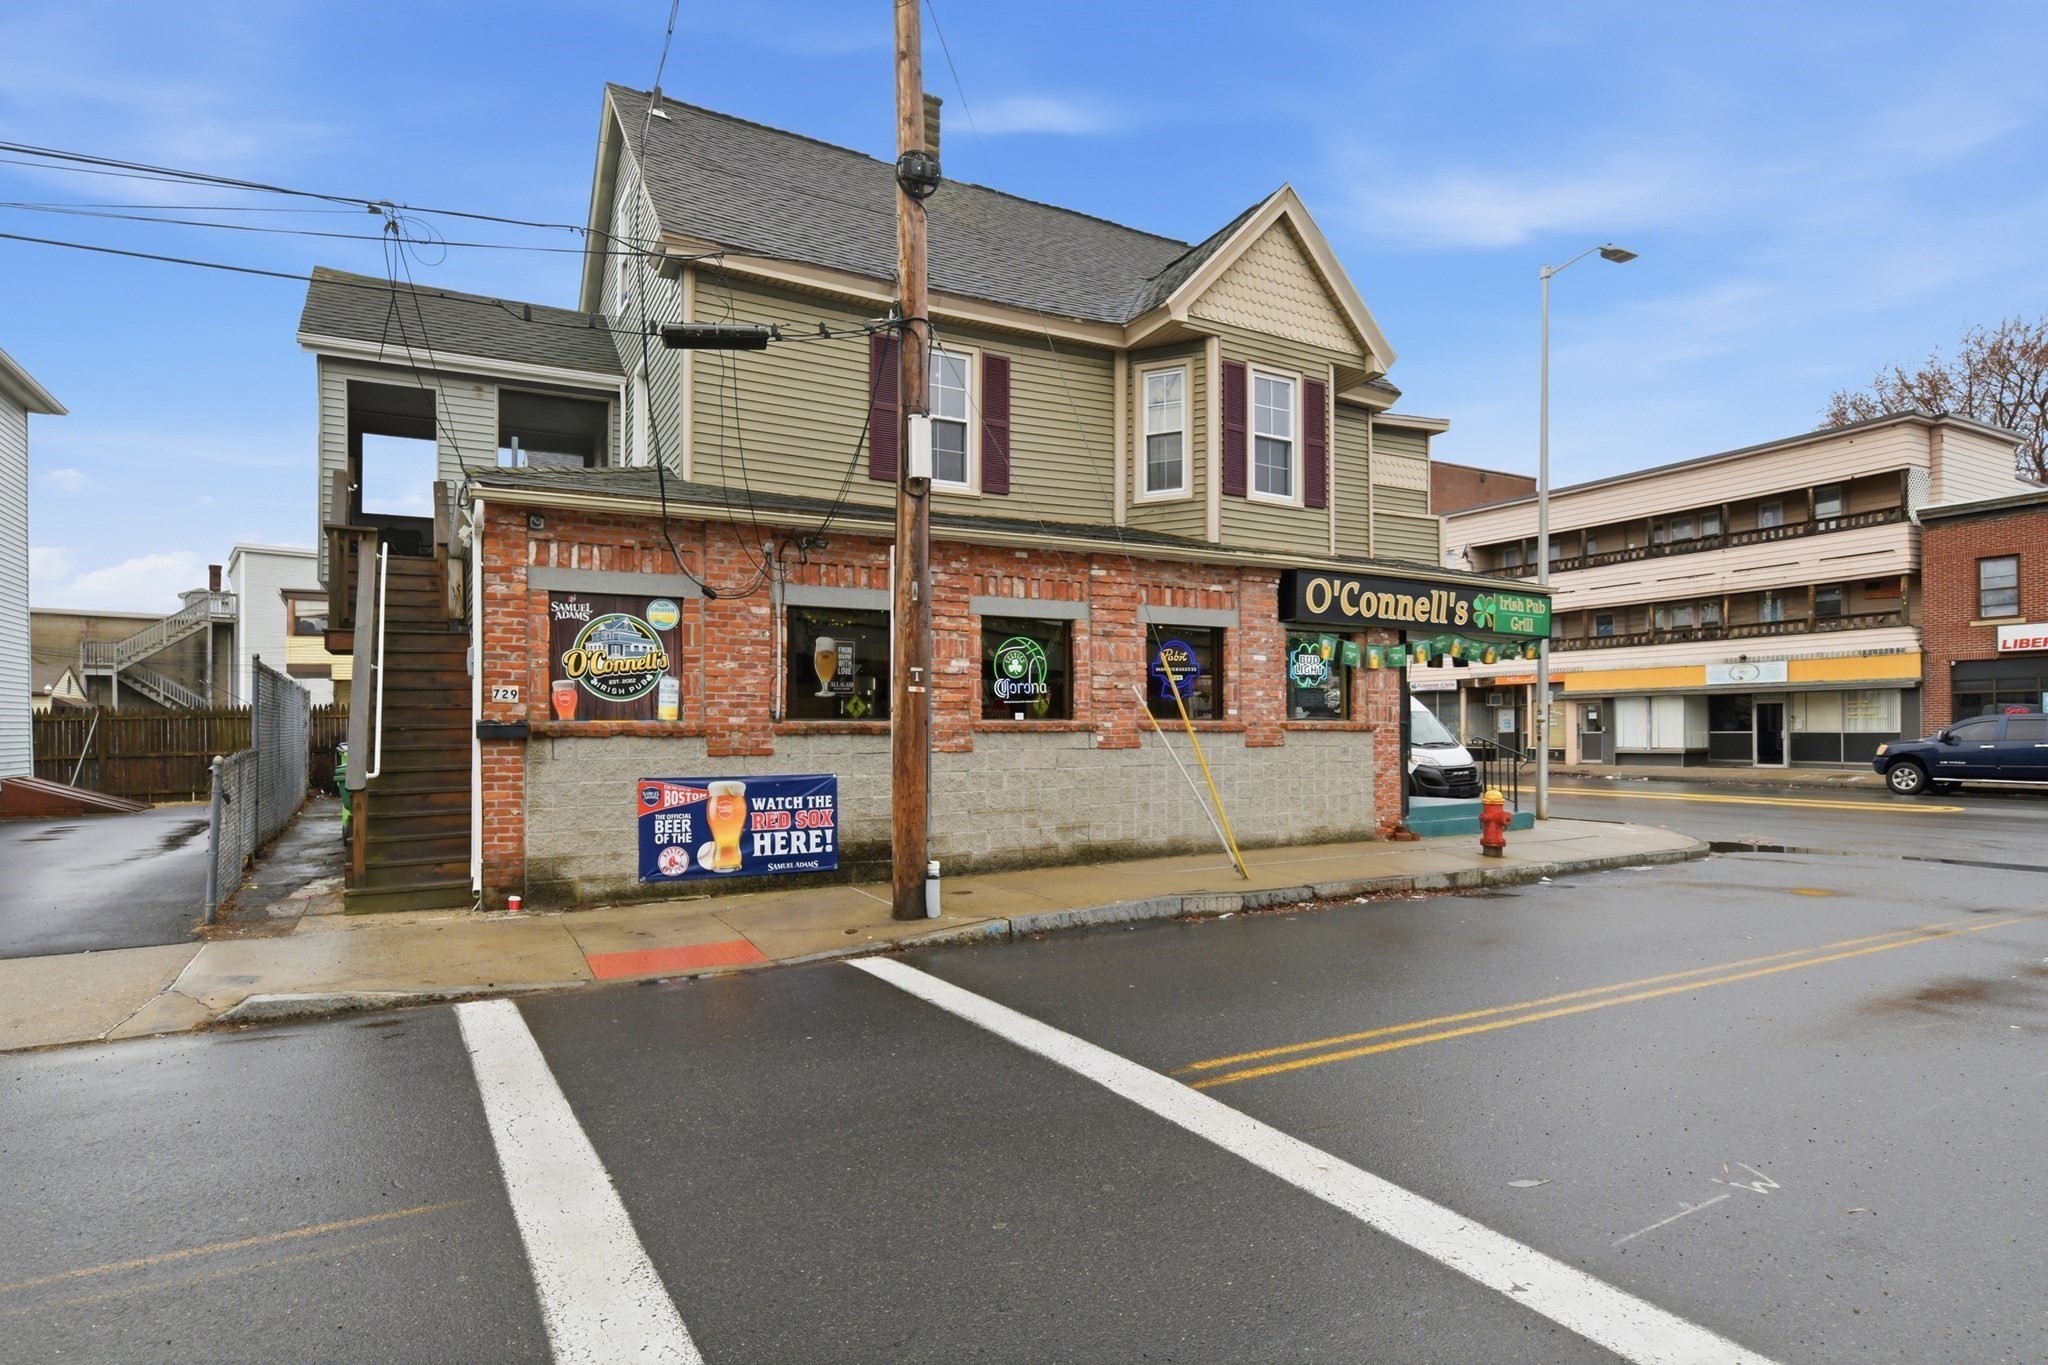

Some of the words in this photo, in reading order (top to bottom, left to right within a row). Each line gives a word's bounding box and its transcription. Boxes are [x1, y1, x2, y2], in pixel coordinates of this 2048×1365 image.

[551, 601, 593, 614] SAMUEL
[1305, 577, 1469, 625] O'Connell's
[1499, 595, 1524, 613] Irish
[1525, 598, 1546, 614] Pub
[554, 611, 590, 621] ADAMS
[1510, 617, 1534, 632] Grill
[1005, 652, 1025, 663] CELTICS
[1163, 648, 1188, 661] Pabst
[1299, 655, 1320, 665] BUD
[563, 648, 669, 677] O'Connell's
[1294, 664, 1324, 675] LIGHT
[838, 667, 852, 675] LOVE
[494, 689, 517, 699] 729
[597, 682, 625, 695] IRISH
[629, 679, 648, 693] PUB
[994, 678, 1047, 699] Corona
[663, 790, 707, 807] BOSTON
[751, 796, 803, 810] WATCH
[806, 795, 833, 808] THE
[655, 819, 691, 833] BEER
[751, 811, 791, 831] RED
[795, 809, 834, 829] SOX
[655, 834, 669, 844] OF
[671, 833, 692, 843] THE
[752, 829, 833, 856] HERE!
[768, 862, 794, 871] SAMUEL
[795, 860, 819, 868] ADAMS
